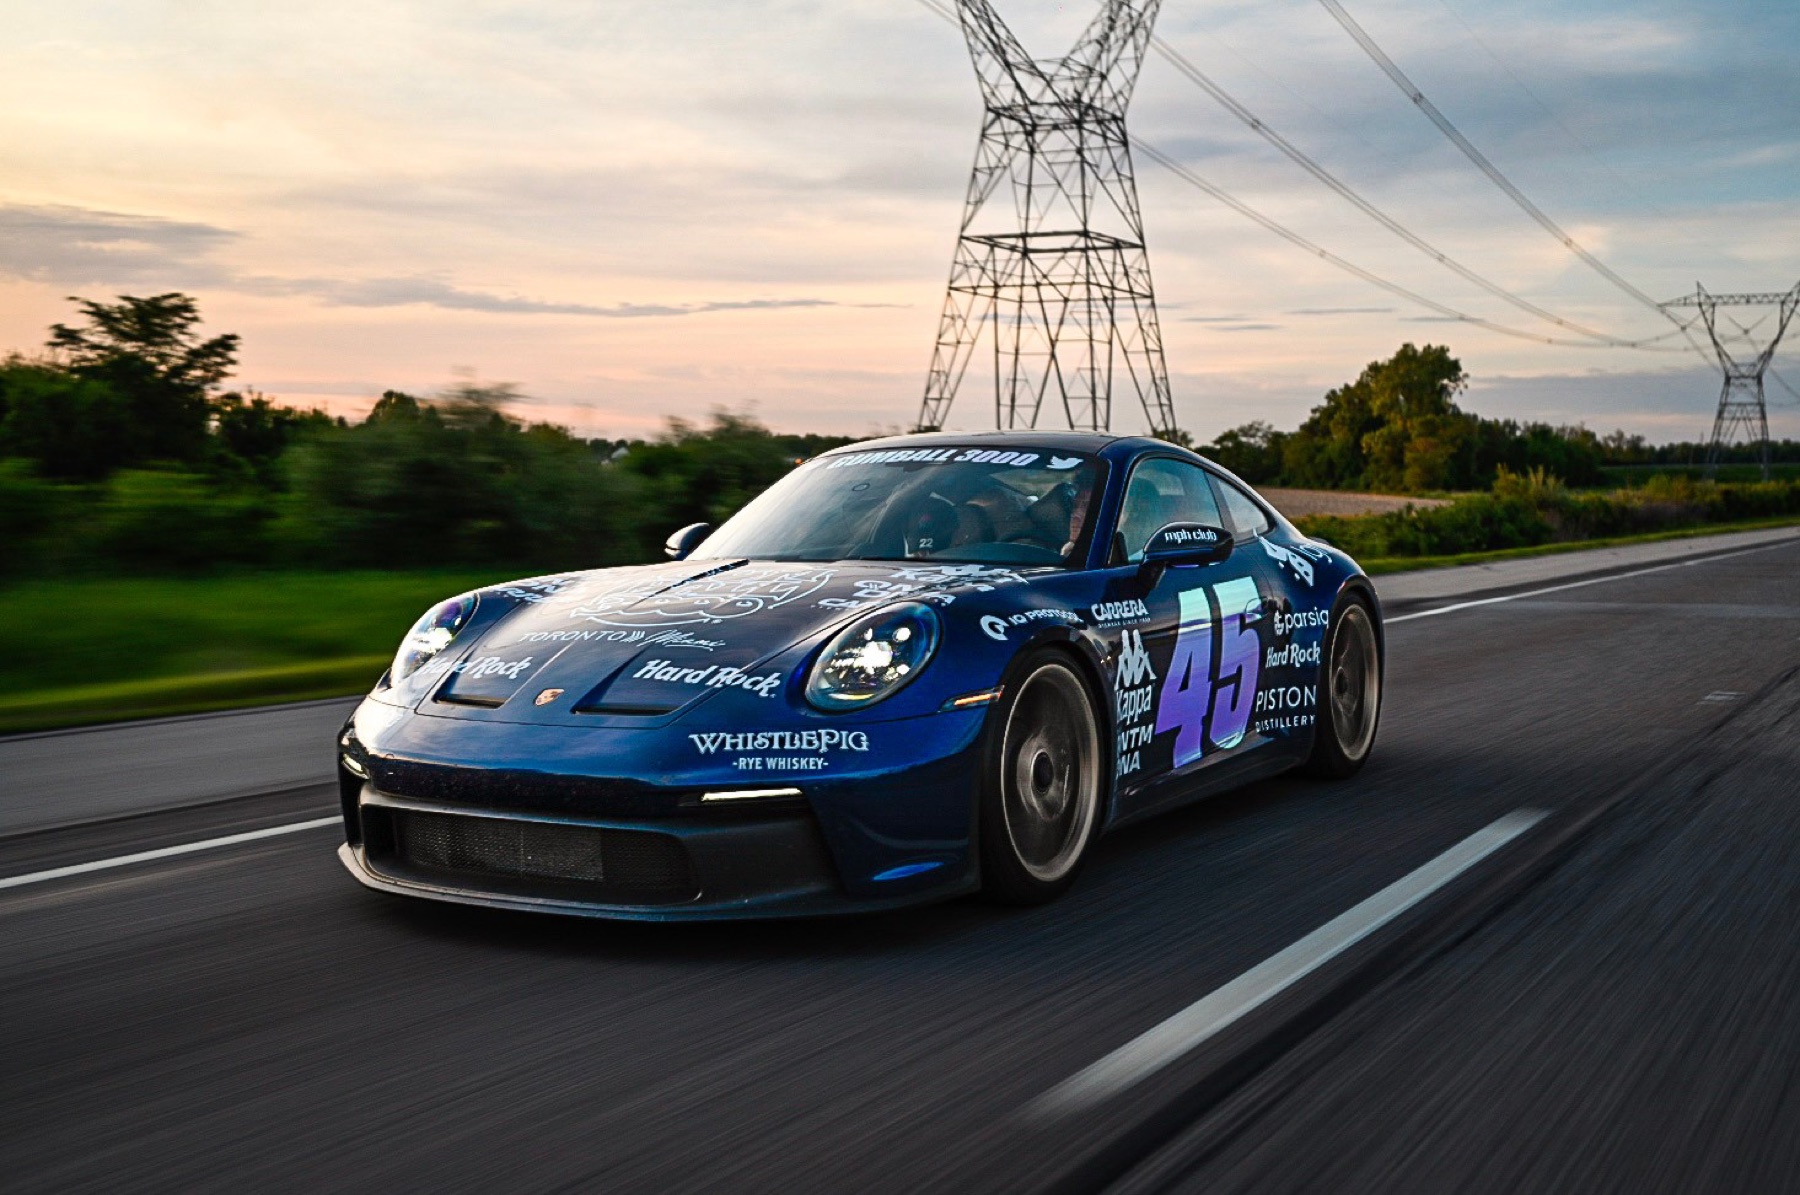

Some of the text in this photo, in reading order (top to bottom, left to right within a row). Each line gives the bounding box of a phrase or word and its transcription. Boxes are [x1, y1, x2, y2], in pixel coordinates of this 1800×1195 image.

[826, 449, 1040, 469] GUMBALL 3000
[919, 538, 934, 548] 22
[1165, 529, 1217, 544] mph club
[1091, 598, 1149, 621] CARRERA
[1284, 606, 1330, 635] parsiq
[518, 630, 628, 642] TORONTO
[1264, 640, 1321, 668] Hard Rock
[469, 656, 534, 679] Rock
[633, 658, 782, 697] Hard Rock
[1155, 576, 1262, 769] 45
[1255, 685, 1317, 713] PISTON
[1255, 714, 1316, 733] DISTILLERY
